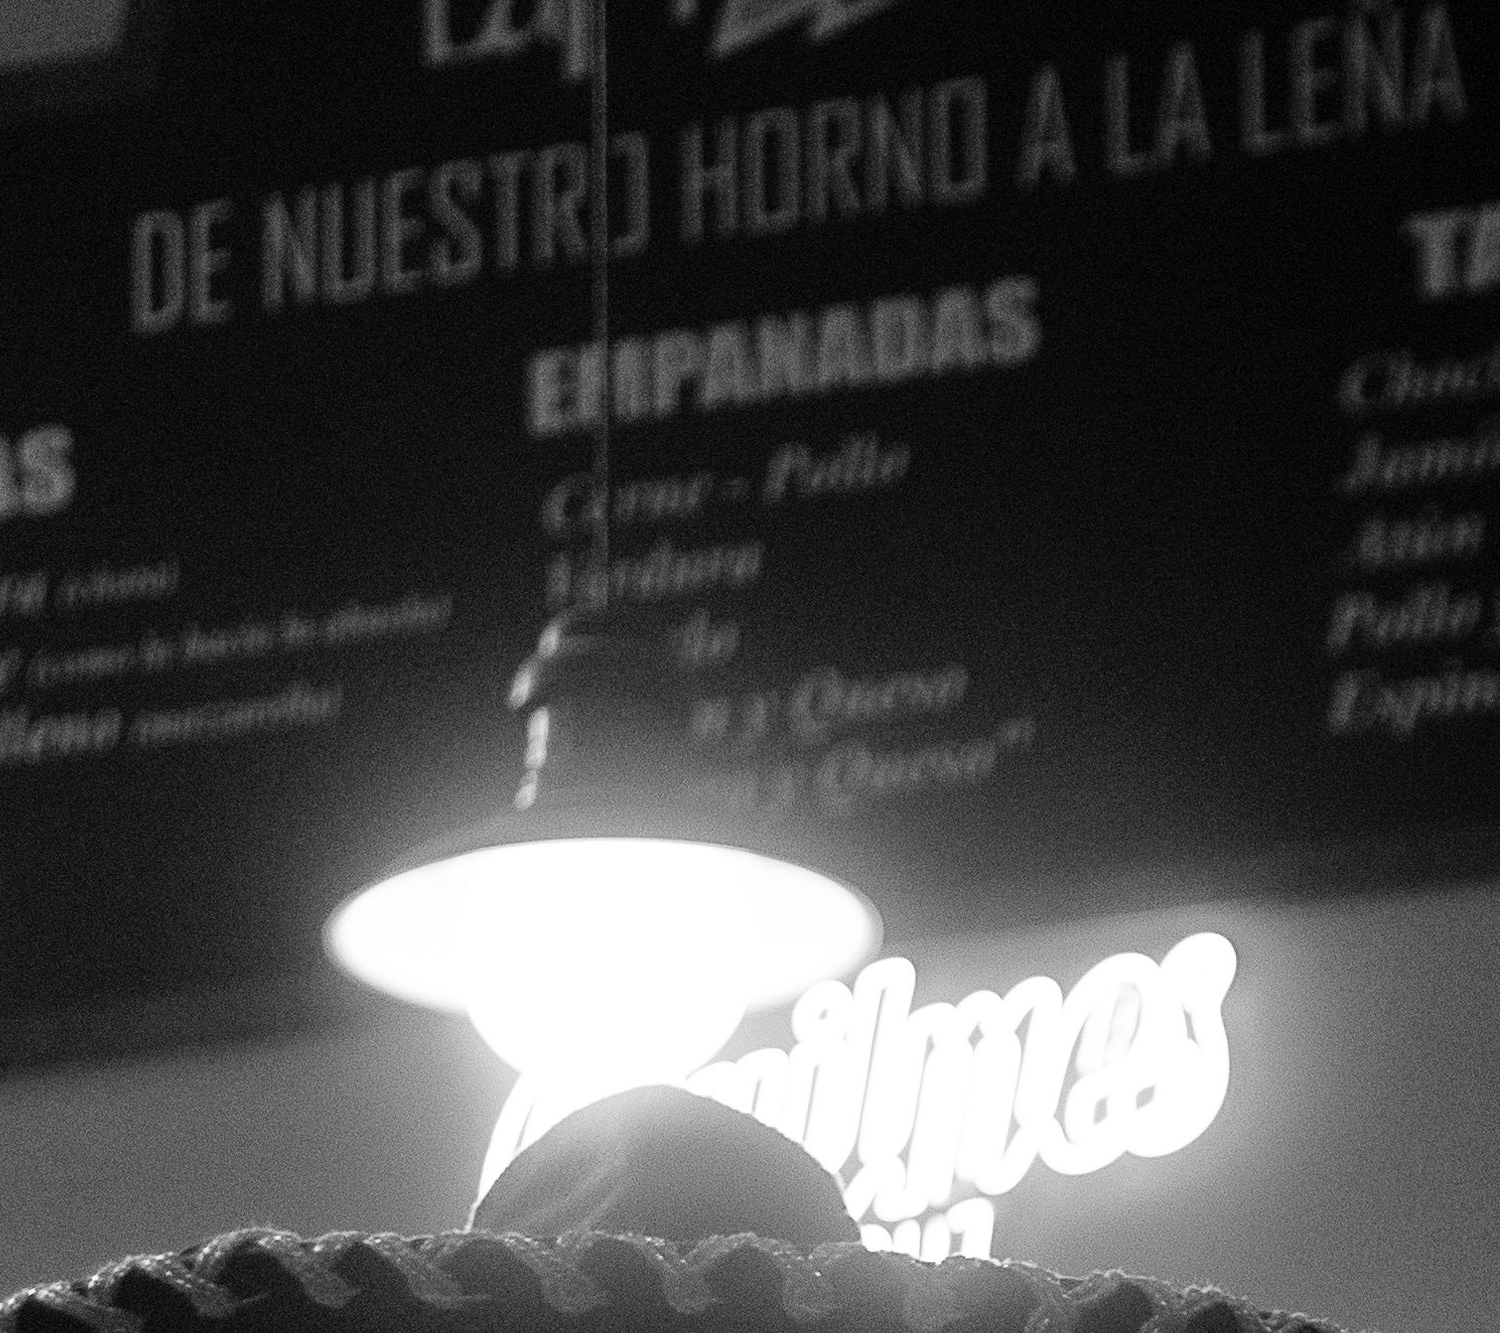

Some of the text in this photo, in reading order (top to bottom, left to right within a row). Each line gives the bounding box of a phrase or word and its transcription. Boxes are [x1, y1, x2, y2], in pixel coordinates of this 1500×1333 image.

[128, 0, 1468, 334] DE NUESTRO HORNO A LA LEÑA
[526, 276, 1040, 438] EMPANADAS
[1326, 584, 1482, 654] Pollo
